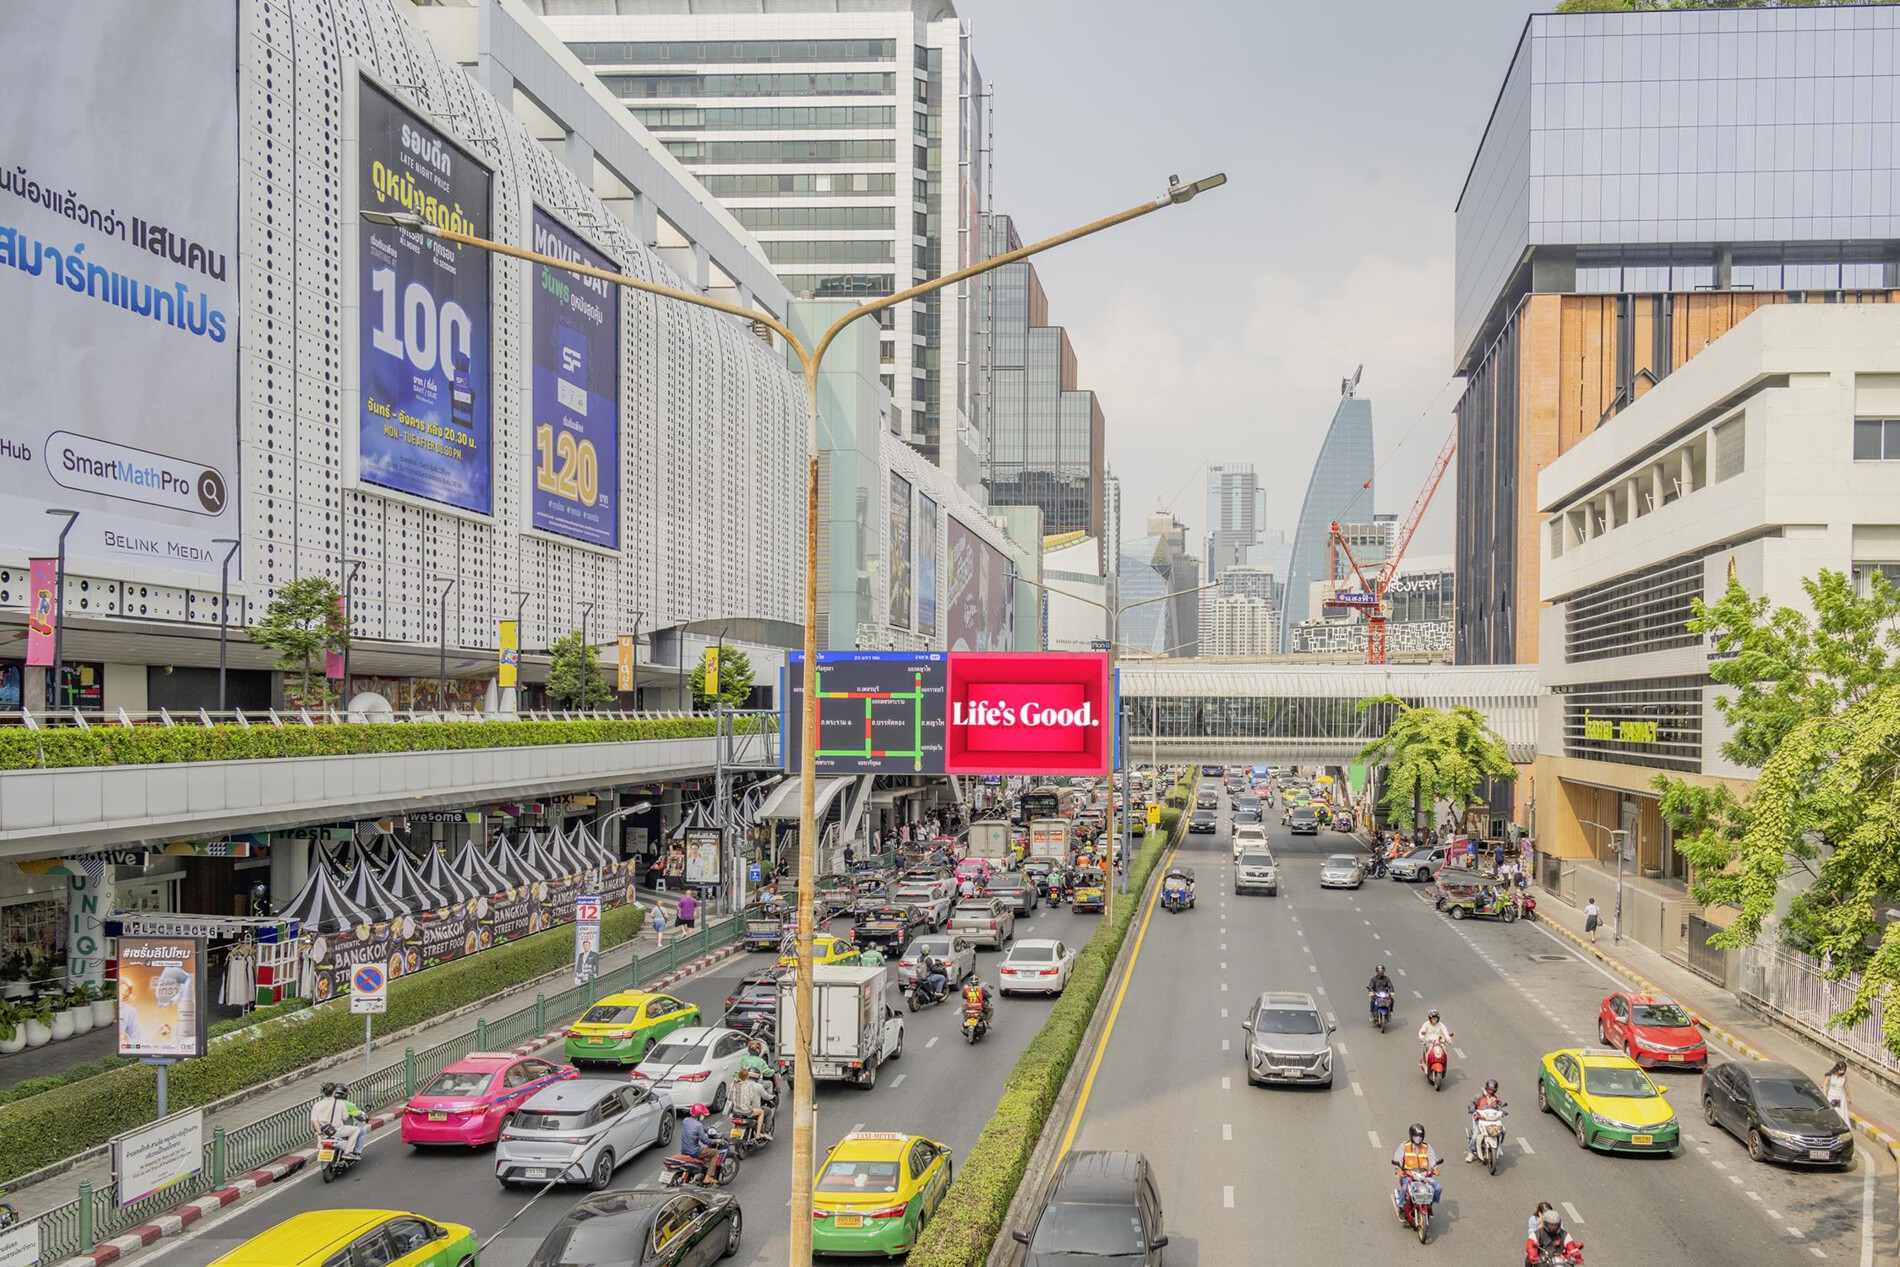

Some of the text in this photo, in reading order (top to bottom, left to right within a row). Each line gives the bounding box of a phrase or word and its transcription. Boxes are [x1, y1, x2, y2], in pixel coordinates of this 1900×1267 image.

[400, 151, 450, 193] LATE NIGHT PRICE
[373, 161, 475, 250] ดูหนังสดคุ้ม
[132, 216, 226, 282] แสนคน
[535, 223, 609, 299] MOVIE DAY
[0, 226, 226, 343] สมาร์ทแมทโปร
[373, 267, 471, 382] 100
[368, 397, 391, 419] จันทร์
[398, 409, 426, 431] อังคาร
[444, 427, 468, 446] 20.30
[0, 438, 31, 461] Hub
[383, 424, 399, 439] MON
[403, 431, 416, 446] TUE
[416, 437, 435, 451] AFTER
[62, 448, 190, 495] SmartMathPro
[537, 422, 598, 508] 120
[104, 530, 214, 562] BELINK MEDIA
[1345, 592, 1374, 602] แสงฟ้า
[1384, 579, 1438, 593] ISCOVERY
[952, 700, 1100, 727] Life's Good.
[494, 903, 529, 924] BANGKOK
[579, 905, 598, 920] 12
[423, 920, 465, 944] BANGKOK
[493, 917, 529, 936] STREET FOOD
[334, 939, 361, 951] AUTHENTIC
[334, 942, 388, 969] BANGKOK
[423, 937, 465, 957] STREET FOOD
[335, 968, 352, 983] STR
